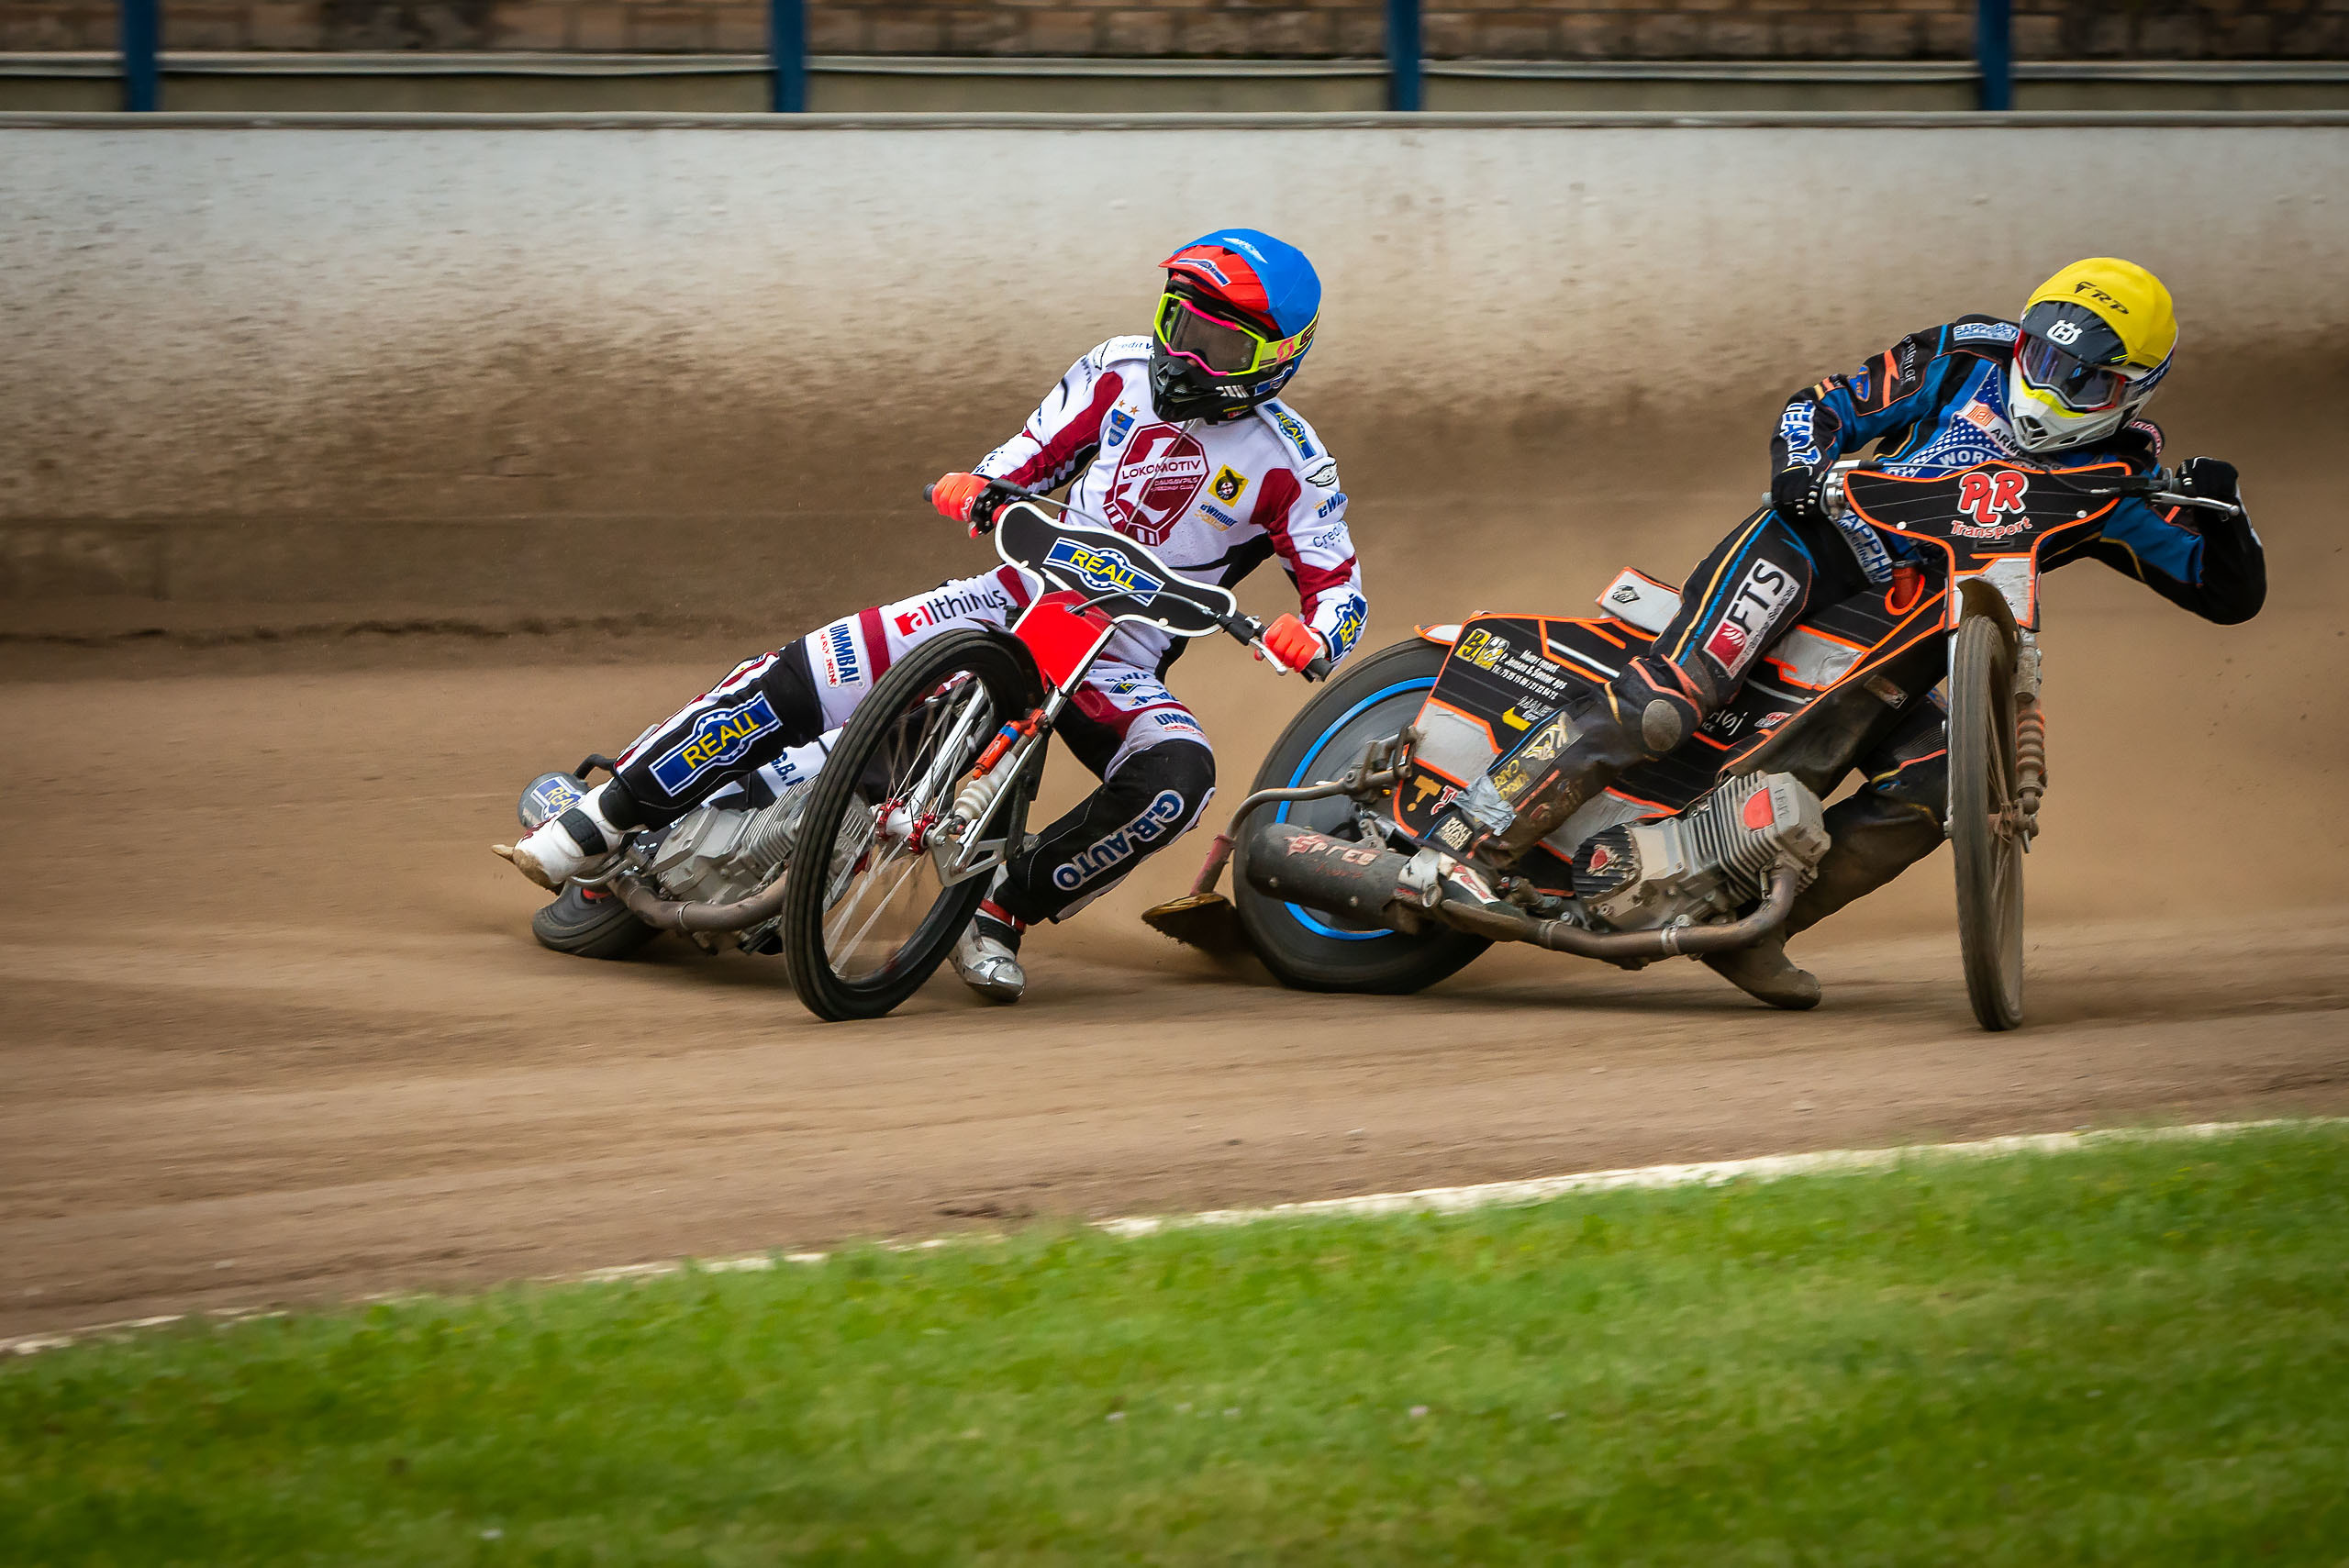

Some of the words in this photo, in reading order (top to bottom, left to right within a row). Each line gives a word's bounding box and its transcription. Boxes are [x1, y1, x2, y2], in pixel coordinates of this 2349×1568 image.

[2075, 282, 2129, 315] FRP
[1275, 412, 1307, 448] REALL
[1780, 400, 1816, 451] TEAM
[1122, 460, 1201, 480] LOKOMOTIV
[1951, 516, 2032, 539] Transport
[1069, 550, 1135, 590] REALL
[1726, 563, 1786, 637] FTS
[829, 623, 861, 684] UMMBA!
[682, 713, 760, 769] REALL
[1055, 791, 1182, 889] G.B.AUTO
